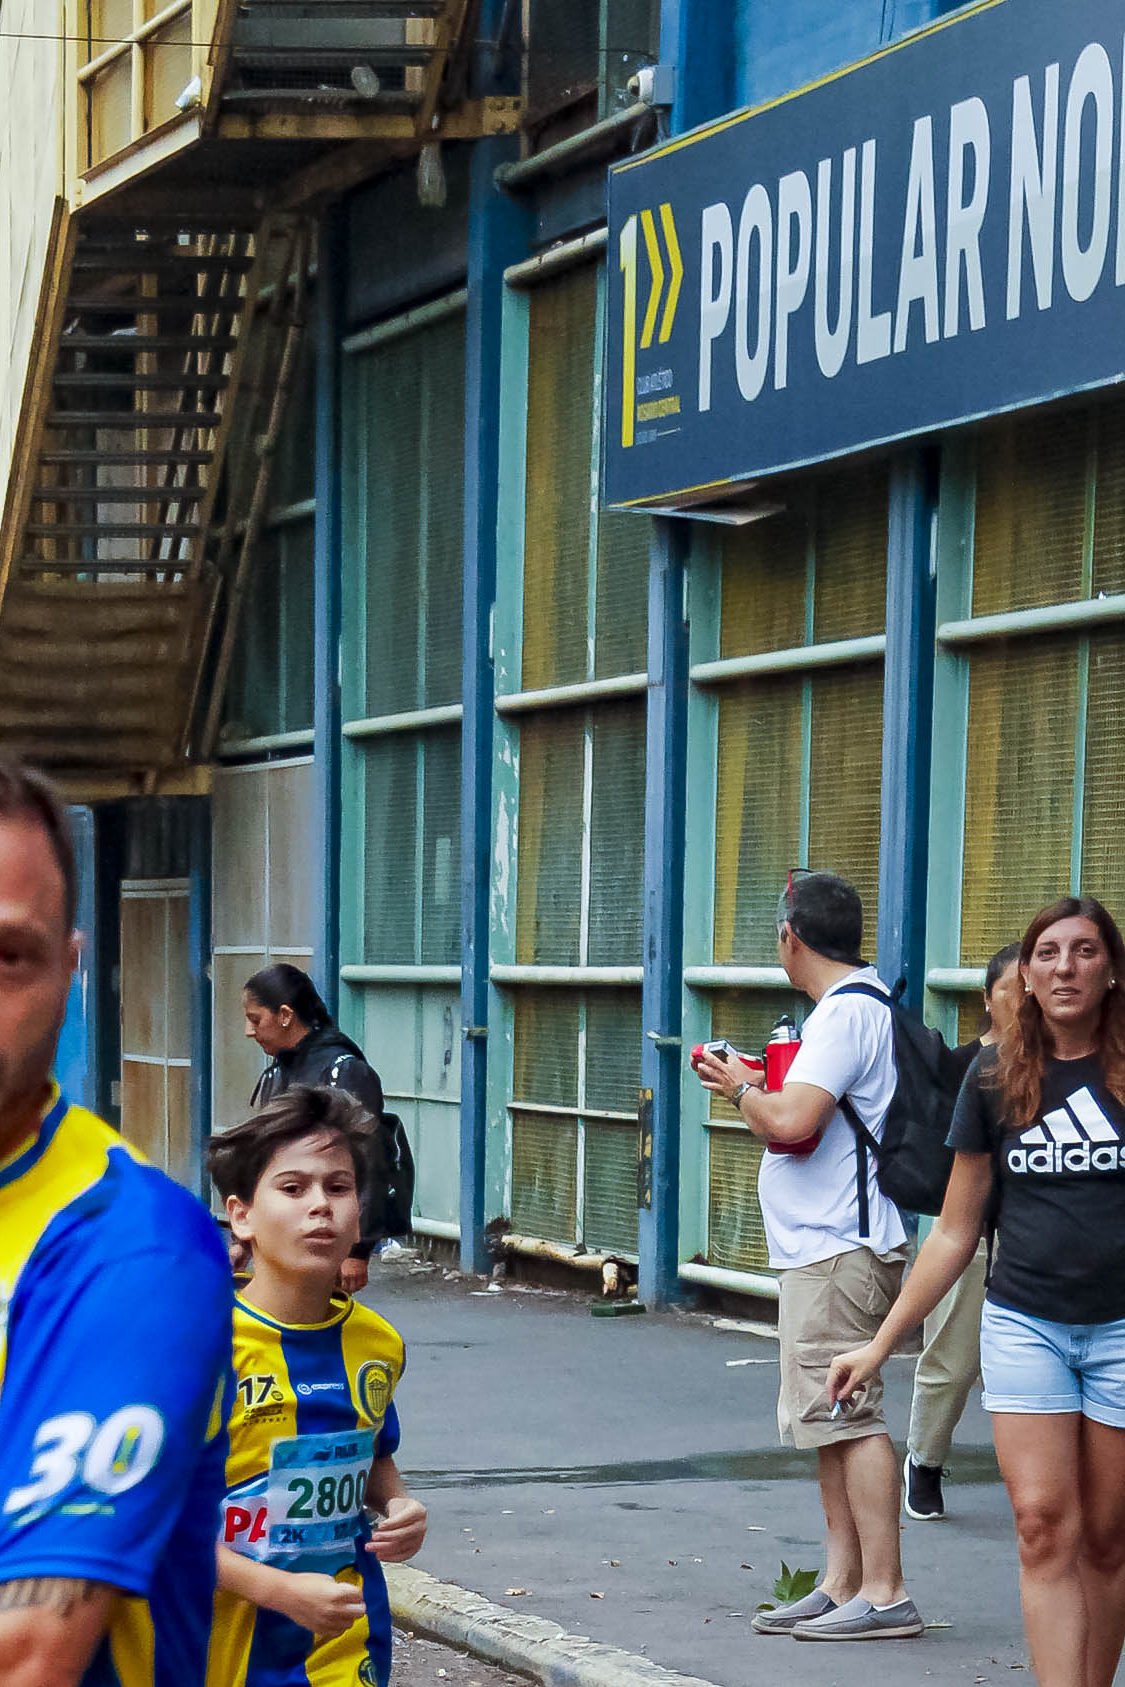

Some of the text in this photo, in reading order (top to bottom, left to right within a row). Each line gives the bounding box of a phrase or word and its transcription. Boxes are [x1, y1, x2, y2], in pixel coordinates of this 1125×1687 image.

[698, 32, 1125, 413] POPULAR NO
[238, 1375, 276, 1406] 17
[2, 1403, 165, 1515] 30
[286, 1469, 369, 1519] 2800
